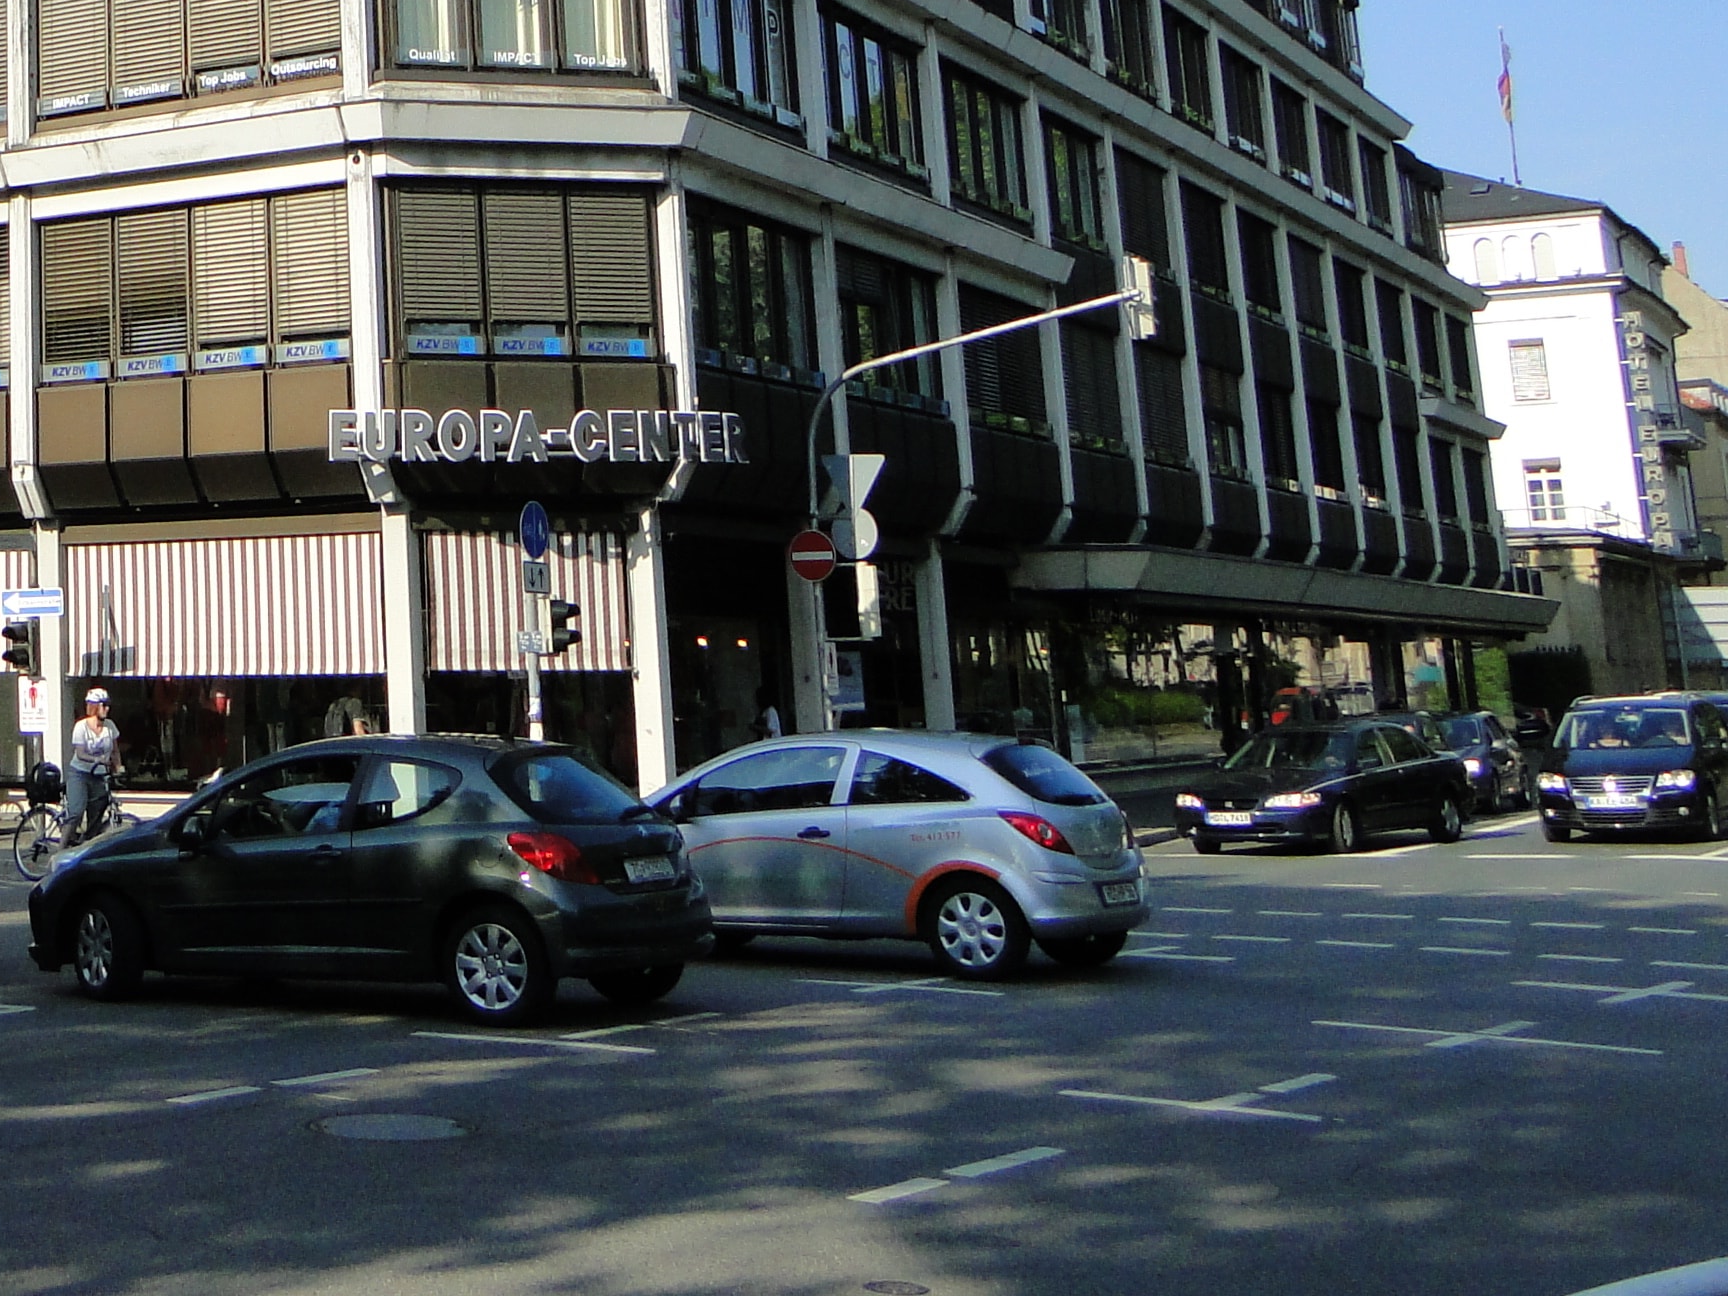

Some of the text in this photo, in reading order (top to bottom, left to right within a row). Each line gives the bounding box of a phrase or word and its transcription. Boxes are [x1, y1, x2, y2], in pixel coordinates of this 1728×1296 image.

[409, 49, 455, 62] Qualit
[574, 54, 596, 68] Top
[271, 56, 337, 76] Outsourcing
[199, 70, 247, 88] Top Jobs
[122, 83, 171, 99] Techniker
[52, 94, 90, 109] IMPACT
[416, 339, 440, 349] KZV
[502, 340, 526, 350] KZV
[588, 342, 610, 352] KZV
[286, 346, 308, 357] KZV
[205, 353, 226, 364] KZV
[1622, 311, 1654, 412] HOTEL
[52, 367, 72, 377] KZV
[127, 360, 148, 371] KZV
[328, 409, 750, 464] EUROPA-CENTER
